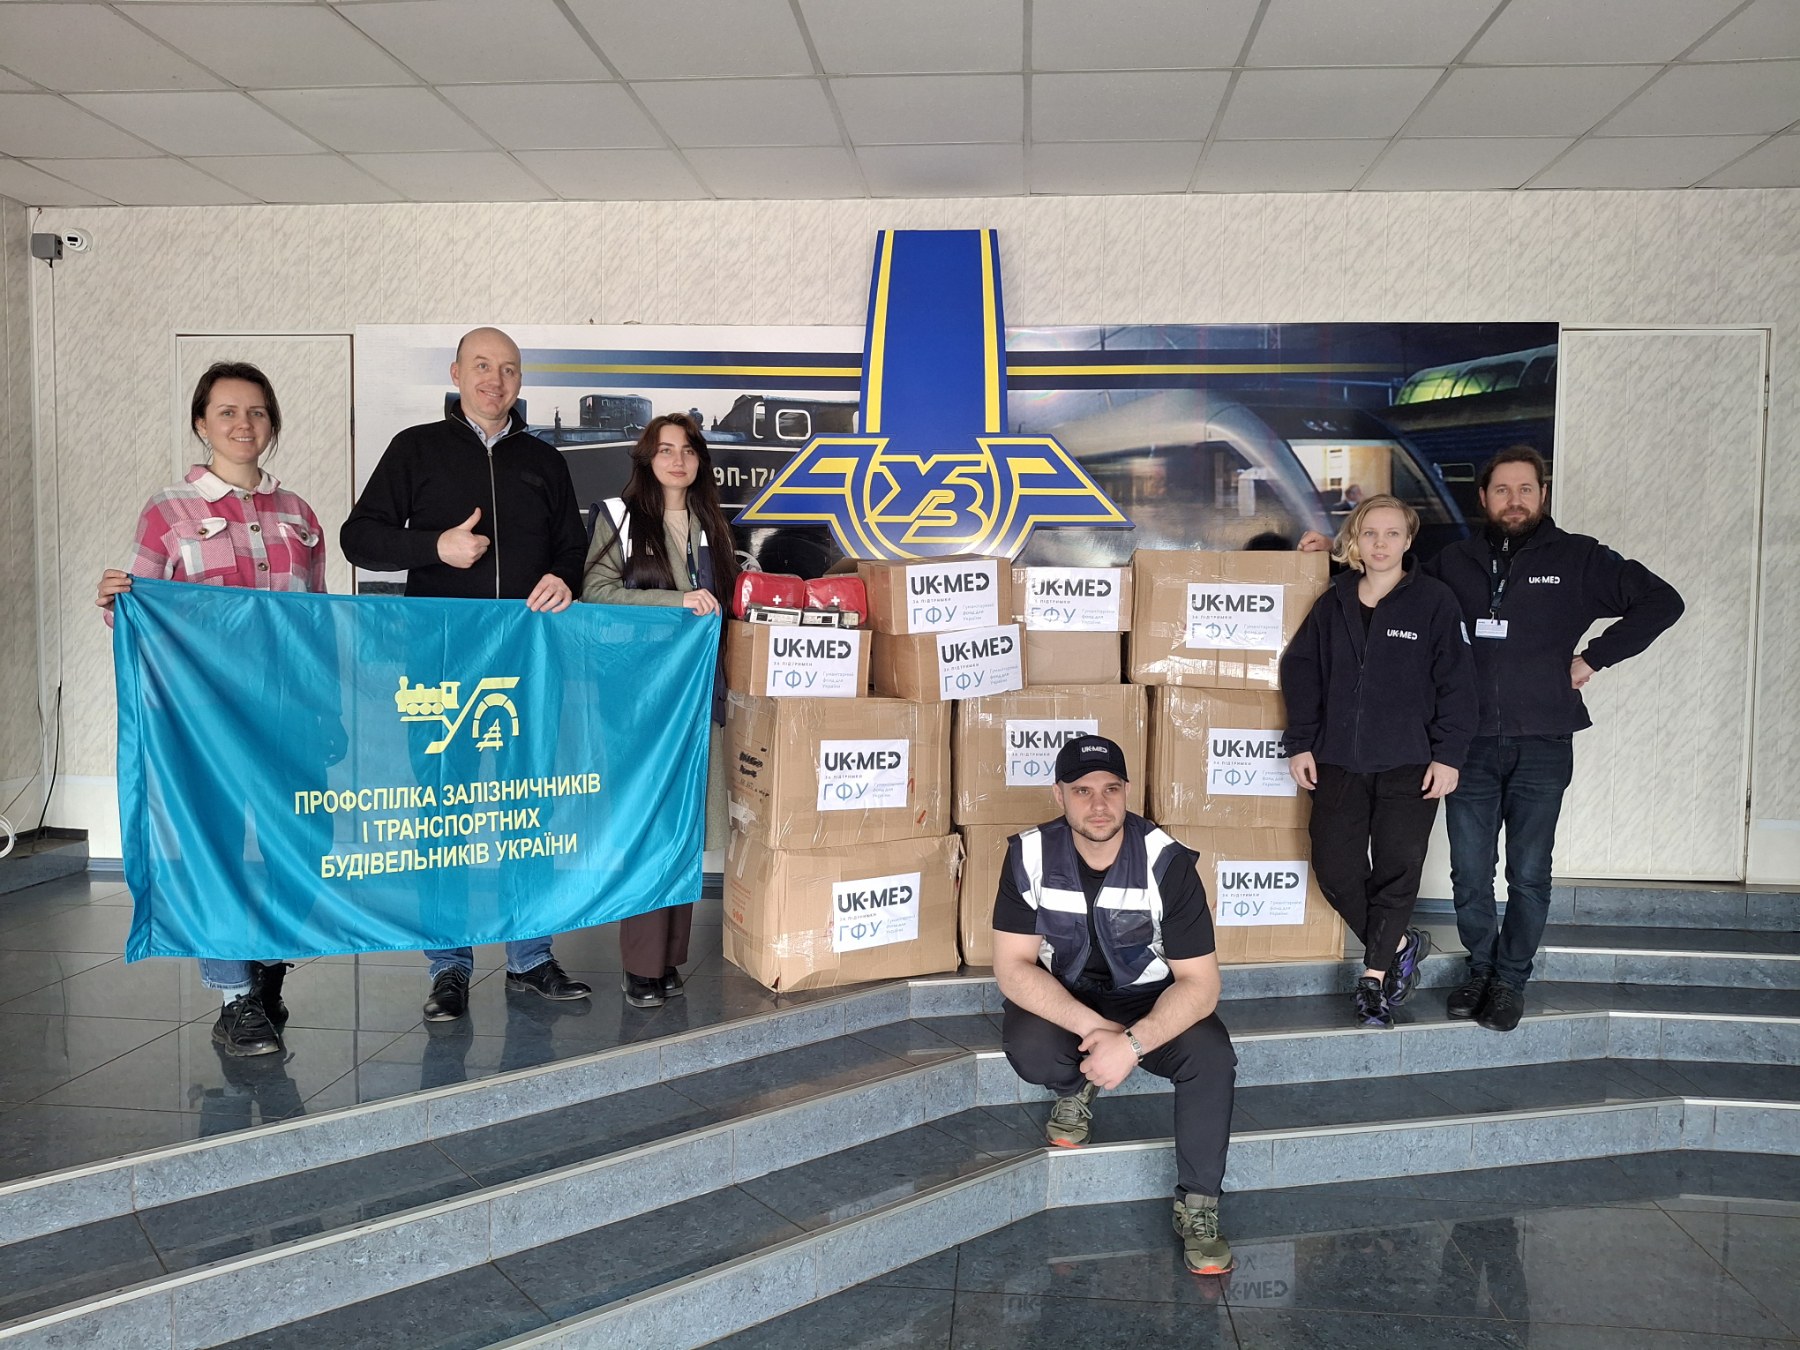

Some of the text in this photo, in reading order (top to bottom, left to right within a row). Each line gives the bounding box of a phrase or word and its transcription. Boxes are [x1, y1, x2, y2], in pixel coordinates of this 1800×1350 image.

[911, 572, 990, 596] UK-MED
[1529, 576, 1560, 584] UK-MED
[1192, 594, 1275, 613] UK-MED
[913, 605, 958, 625] ГФУ
[1387, 629, 1418, 640] UK-MED
[773, 637, 852, 659] UK-MED
[941, 635, 1013, 664] UK-MED
[772, 669, 818, 689] ГФУ
[944, 670, 985, 693] ГФУ
[1011, 730, 1089, 749] UK-ME
[1081, 745, 1108, 753] UK-MED
[824, 751, 901, 771] UK-MED
[1011, 760, 1056, 777] ГФУ
[1212, 769, 1257, 786] ГФУ
[294, 773, 601, 815] ПРОФСПІЛКА ЗАЛІЗНИЧНИКІВ
[823, 782, 869, 801] ГФУ
[362, 807, 540, 843] І ТРАНСПОРТНИХ
[321, 832, 577, 880] БУДІВЕЛЬНИКІВ УКРАЇНИ
[1222, 872, 1300, 890] UK-MED
[838, 885, 912, 913] UK-MED
[1221, 900, 1265, 917] ГФУ
[840, 920, 882, 942] ГФУ
